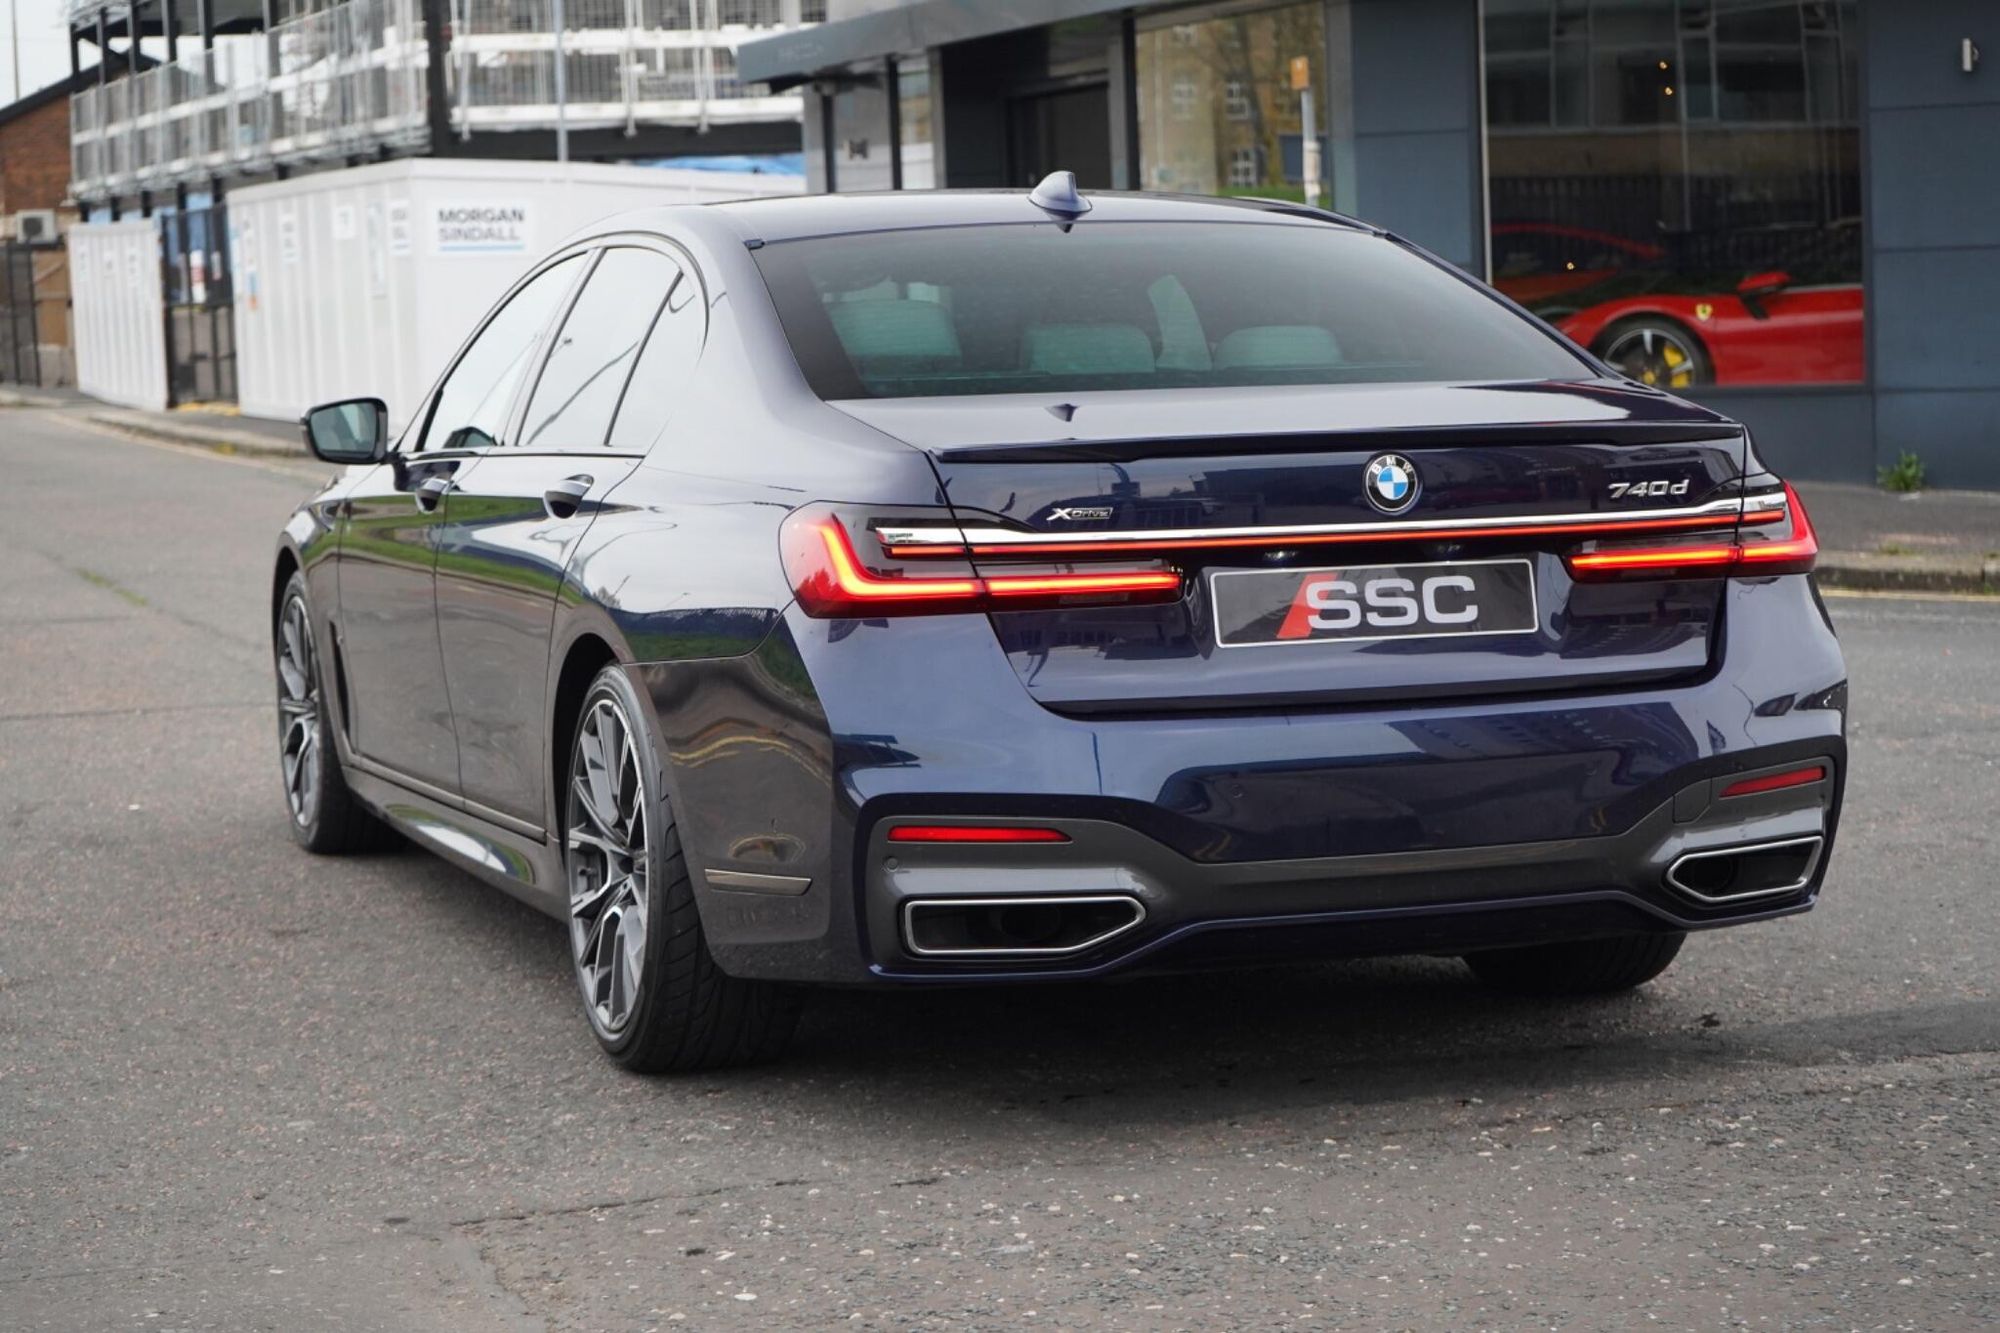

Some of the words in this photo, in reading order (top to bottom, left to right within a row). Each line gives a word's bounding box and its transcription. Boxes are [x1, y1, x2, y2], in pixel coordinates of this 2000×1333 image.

[438, 208, 524, 222] MORGAN
[439, 227, 521, 241] SINDALL
[1371, 456, 1413, 475] BMW
[1608, 479, 1689, 499] 740d
[1306, 575, 1479, 630] SSC
